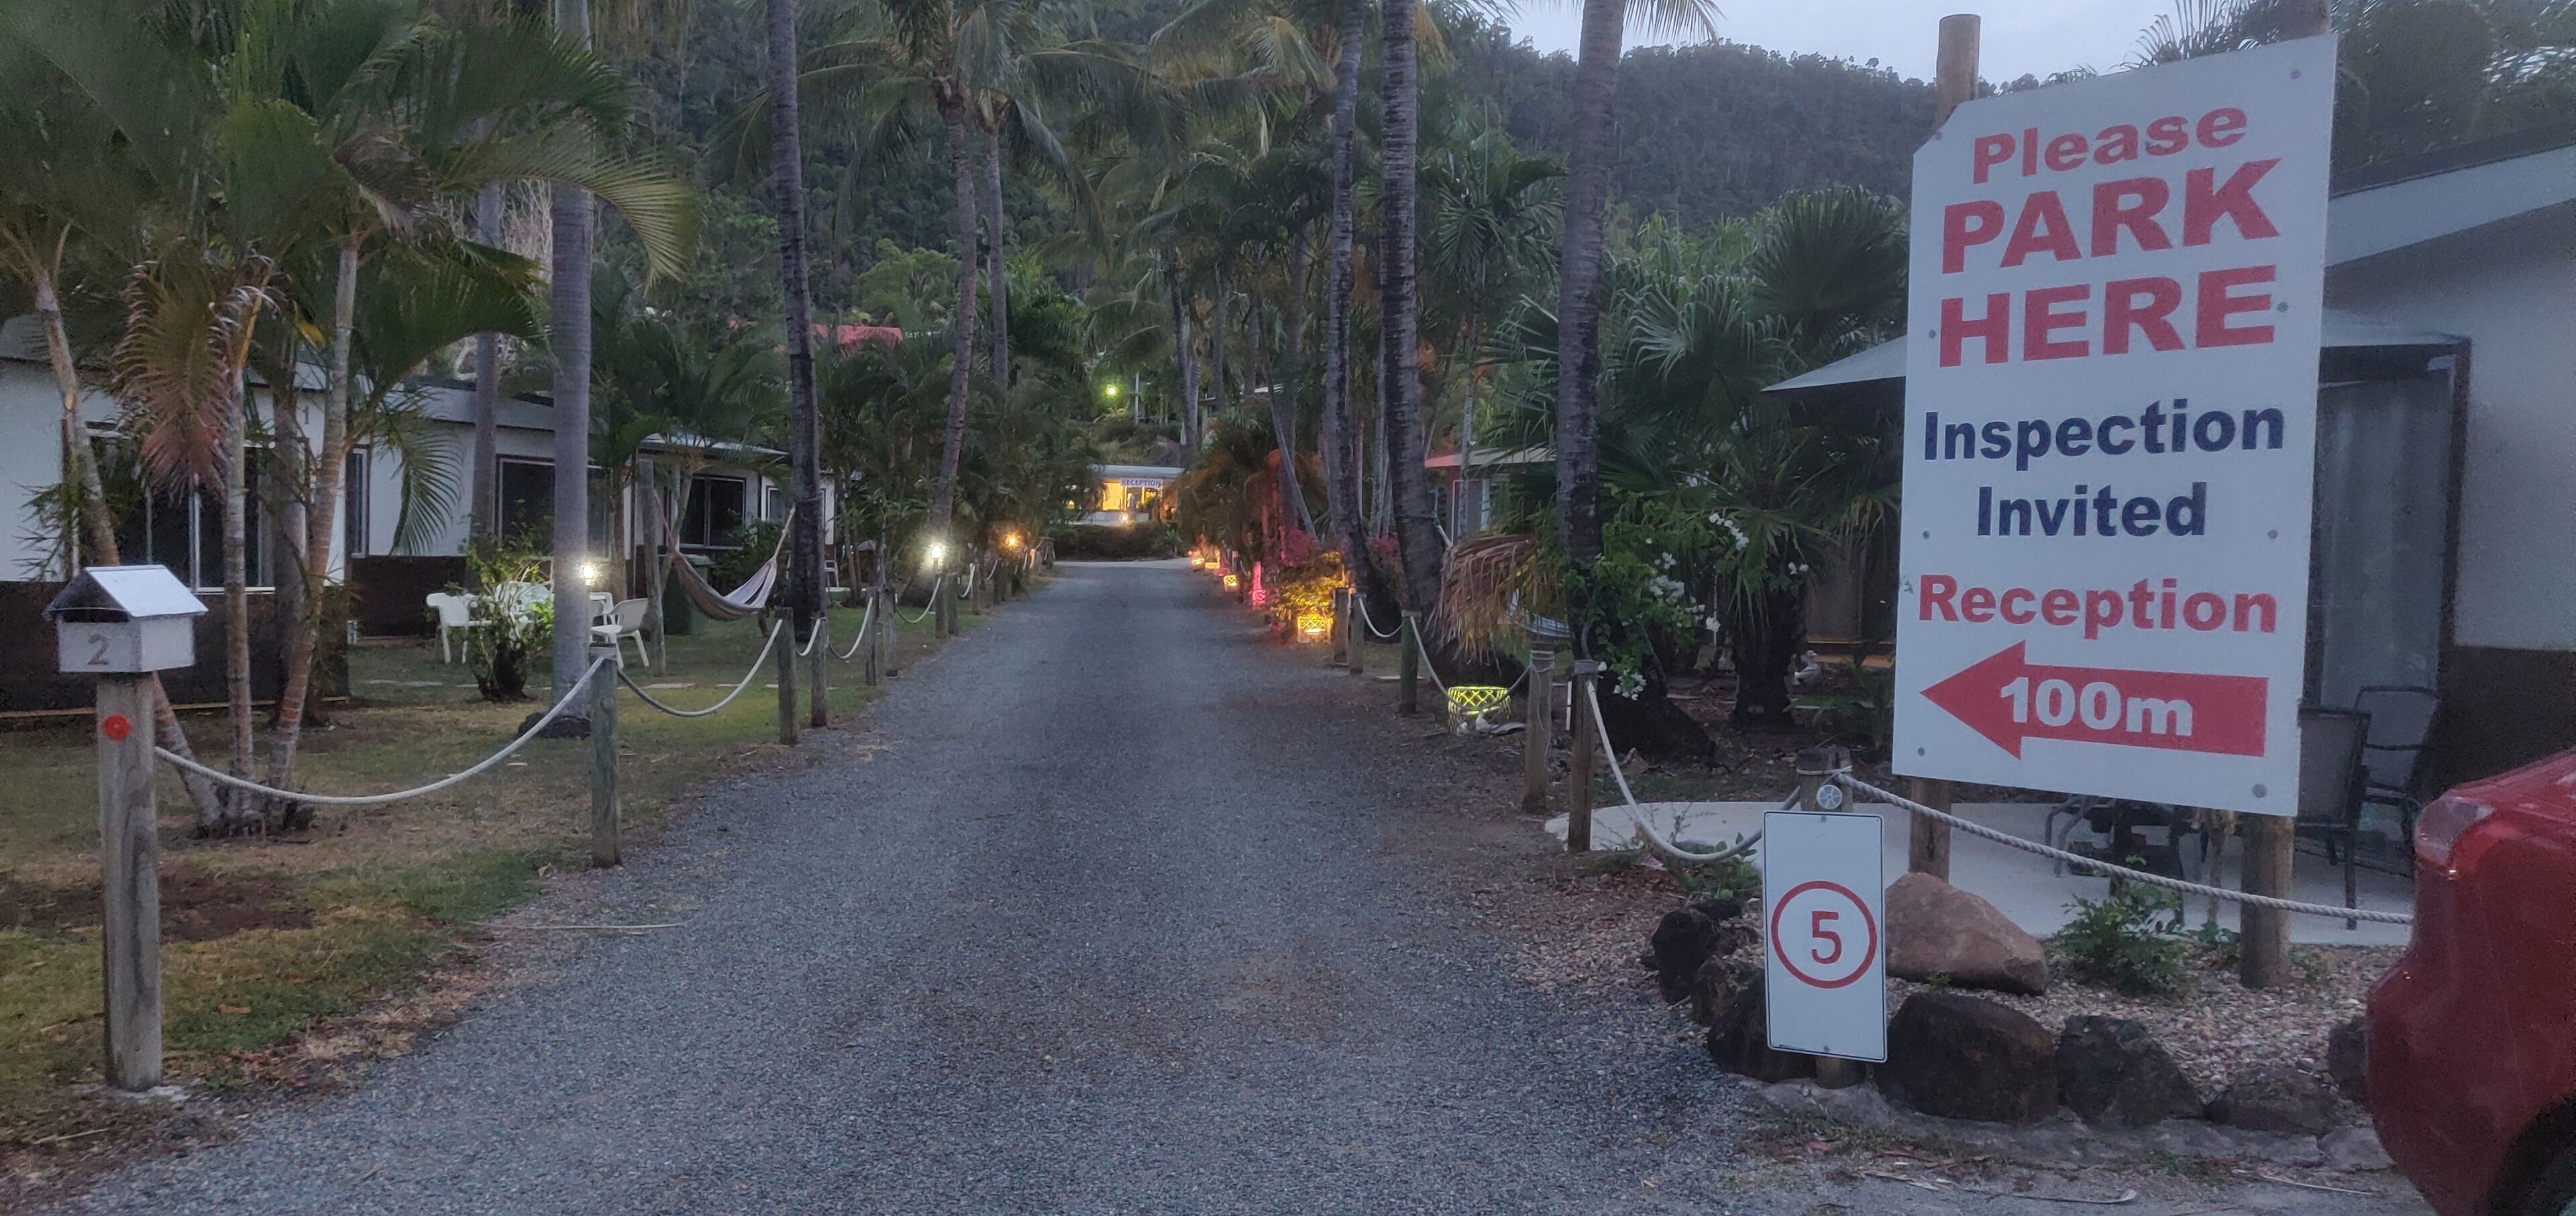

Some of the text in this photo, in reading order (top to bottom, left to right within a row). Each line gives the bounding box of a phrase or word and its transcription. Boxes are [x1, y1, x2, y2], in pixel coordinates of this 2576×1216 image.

[1972, 107, 2247, 184] Please
[1941, 158, 2281, 274] PARK
[1938, 265, 2277, 368] HERE
[1924, 397, 2284, 471] Inspection
[1977, 482, 2208, 537] Invited
[1918, 573, 2277, 639] Reception
[88, 633, 109, 665] 2
[1999, 676, 2192, 736] 100m
[1811, 911, 1841, 964] 5
